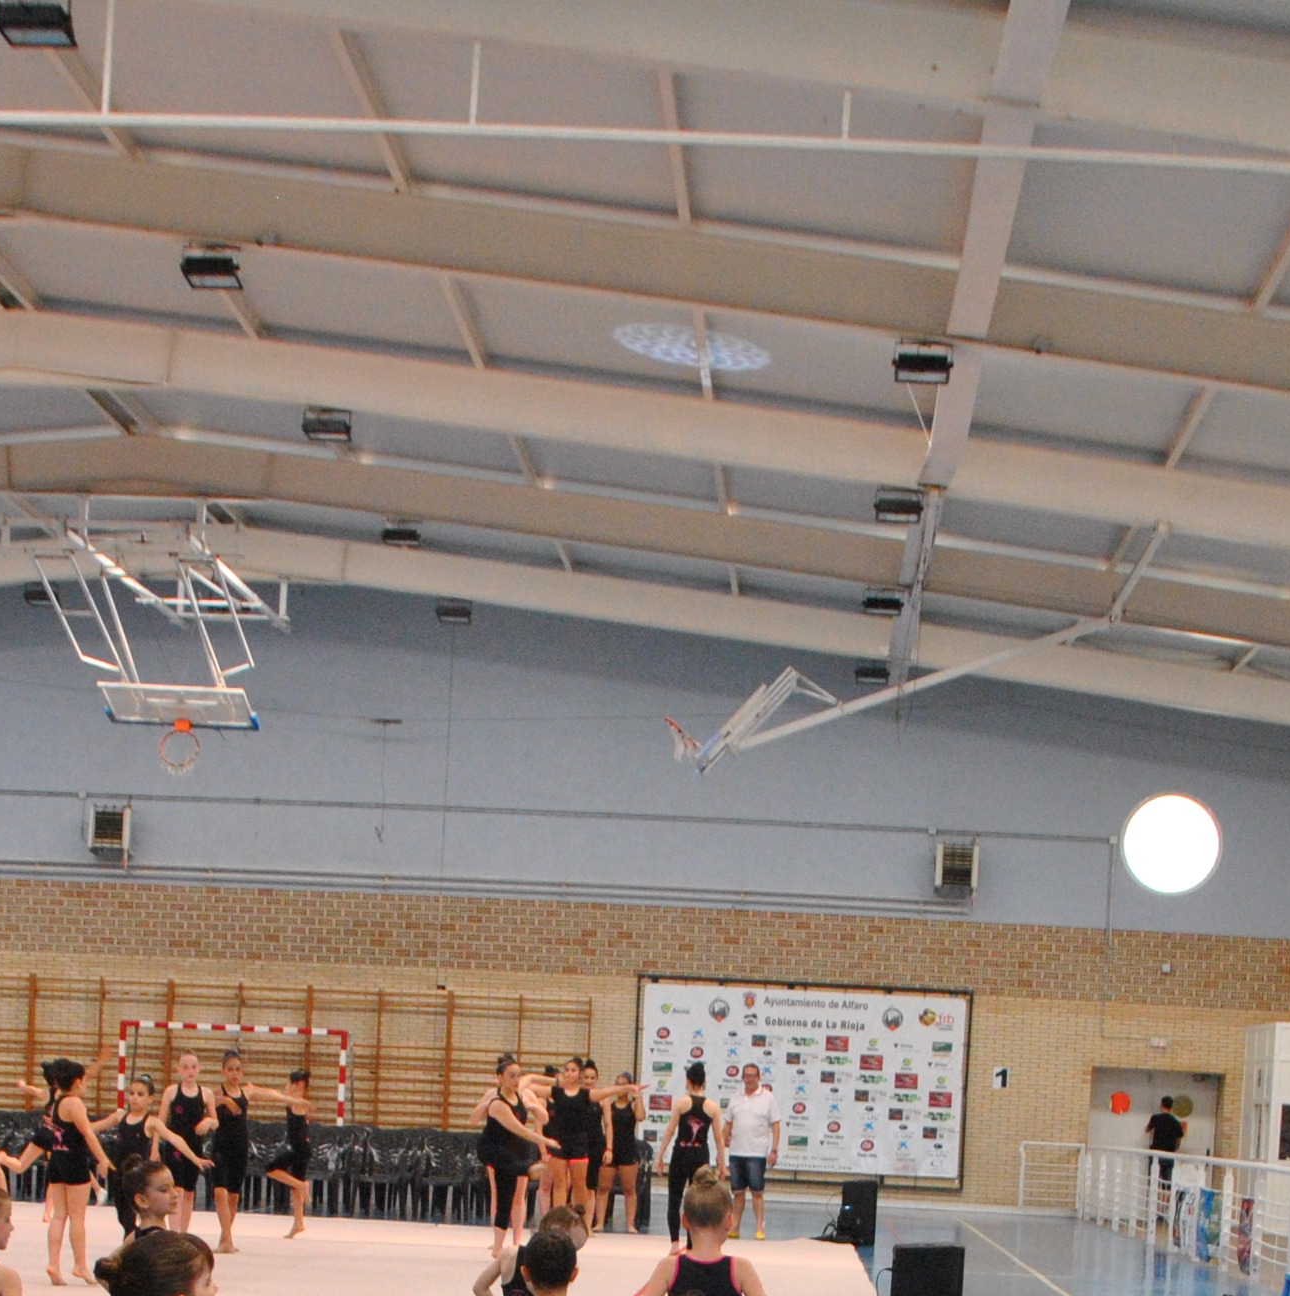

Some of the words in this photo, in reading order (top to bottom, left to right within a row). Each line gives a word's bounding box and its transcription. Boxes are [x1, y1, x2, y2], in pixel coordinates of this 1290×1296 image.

[764, 996, 827, 1010] Ayuntamiento
[829, 999, 840, 1009] de
[841, 1000, 869, 1011] Alfaro
[765, 1017, 808, 1030] Gobierno
[811, 1019, 823, 1030] de
[826, 1019, 838, 1030] La
[840, 1020, 866, 1032] Rioja
[995, 1068, 1008, 1088] 1
